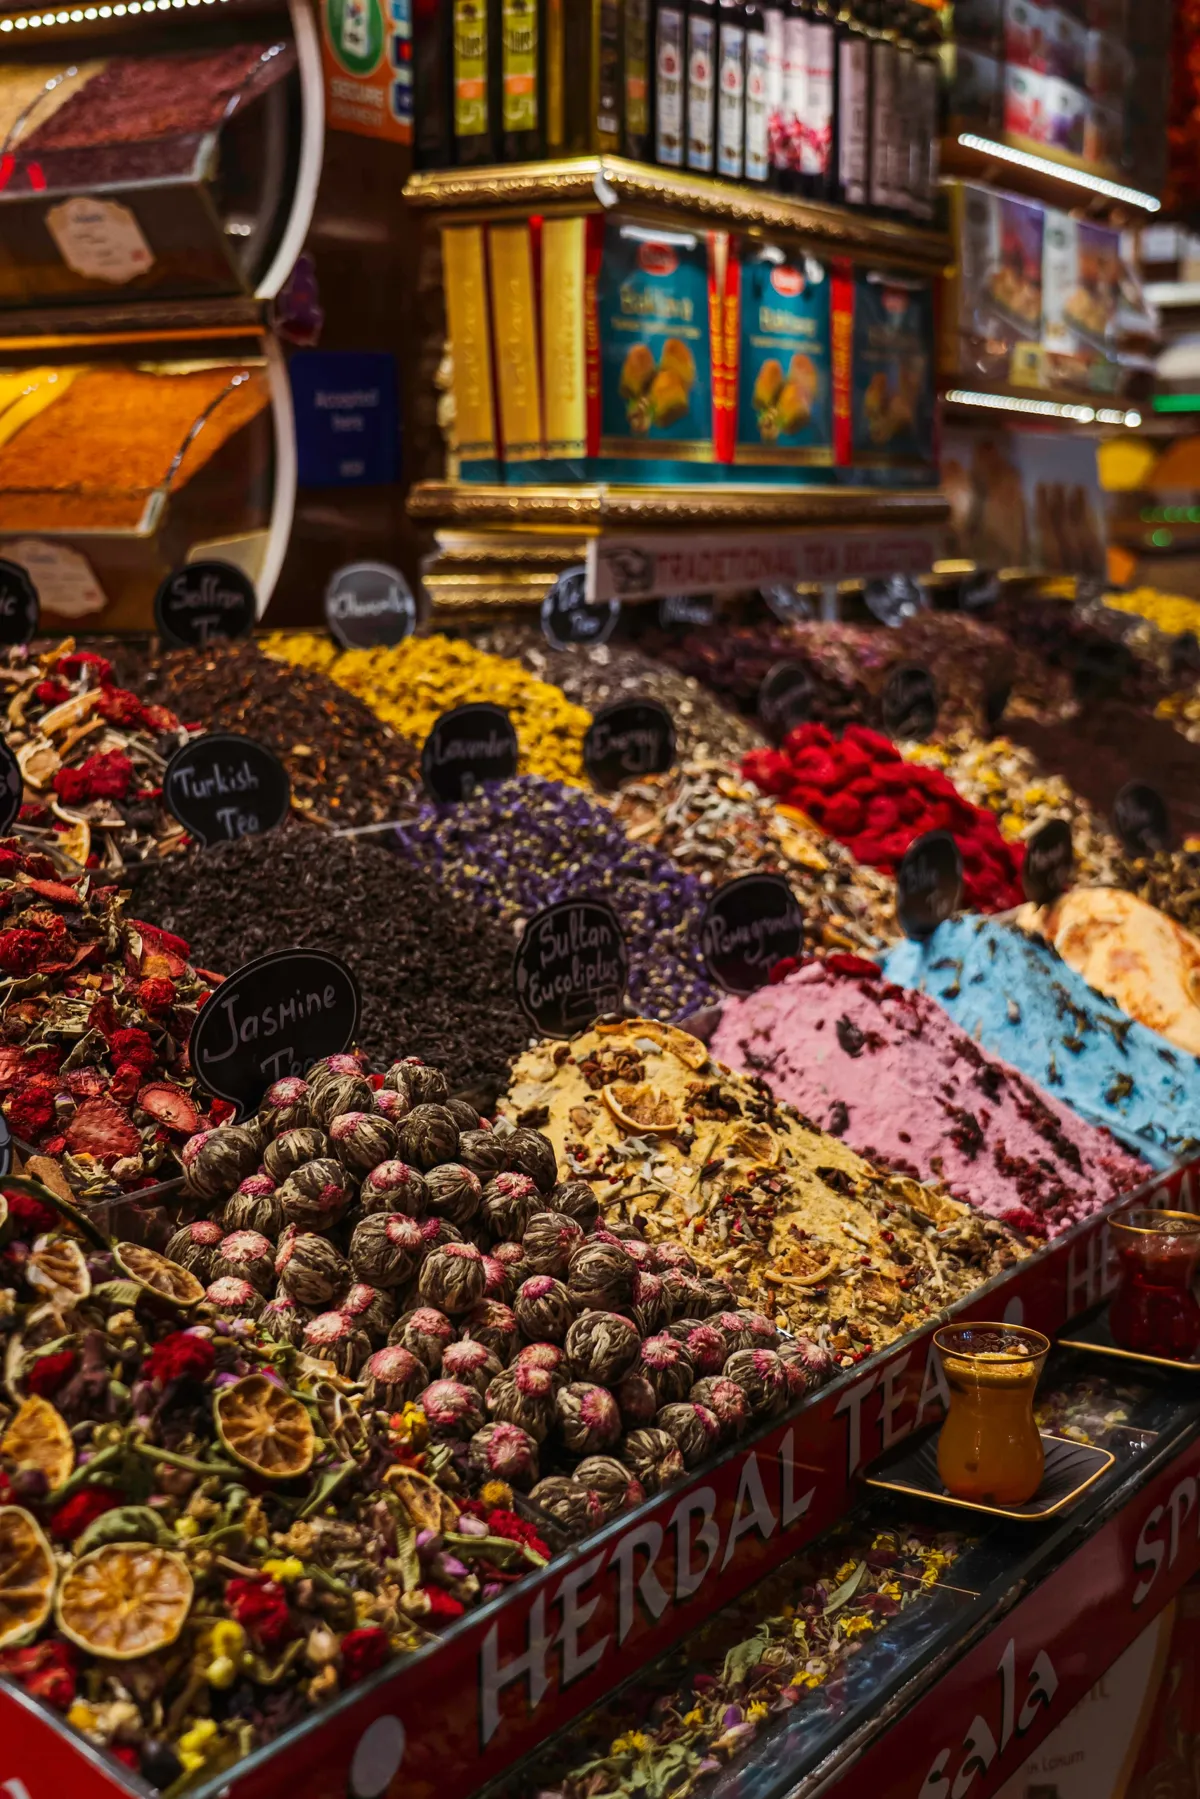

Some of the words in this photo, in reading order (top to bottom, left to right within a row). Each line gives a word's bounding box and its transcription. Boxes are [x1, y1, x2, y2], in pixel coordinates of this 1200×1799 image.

[173, 760, 259, 798] Turkish
[216, 807, 259, 839] Tea
[540, 909, 612, 967] Sultan
[479, 1428, 817, 1745] HERBAL
[833, 1338, 951, 1478] TEA
